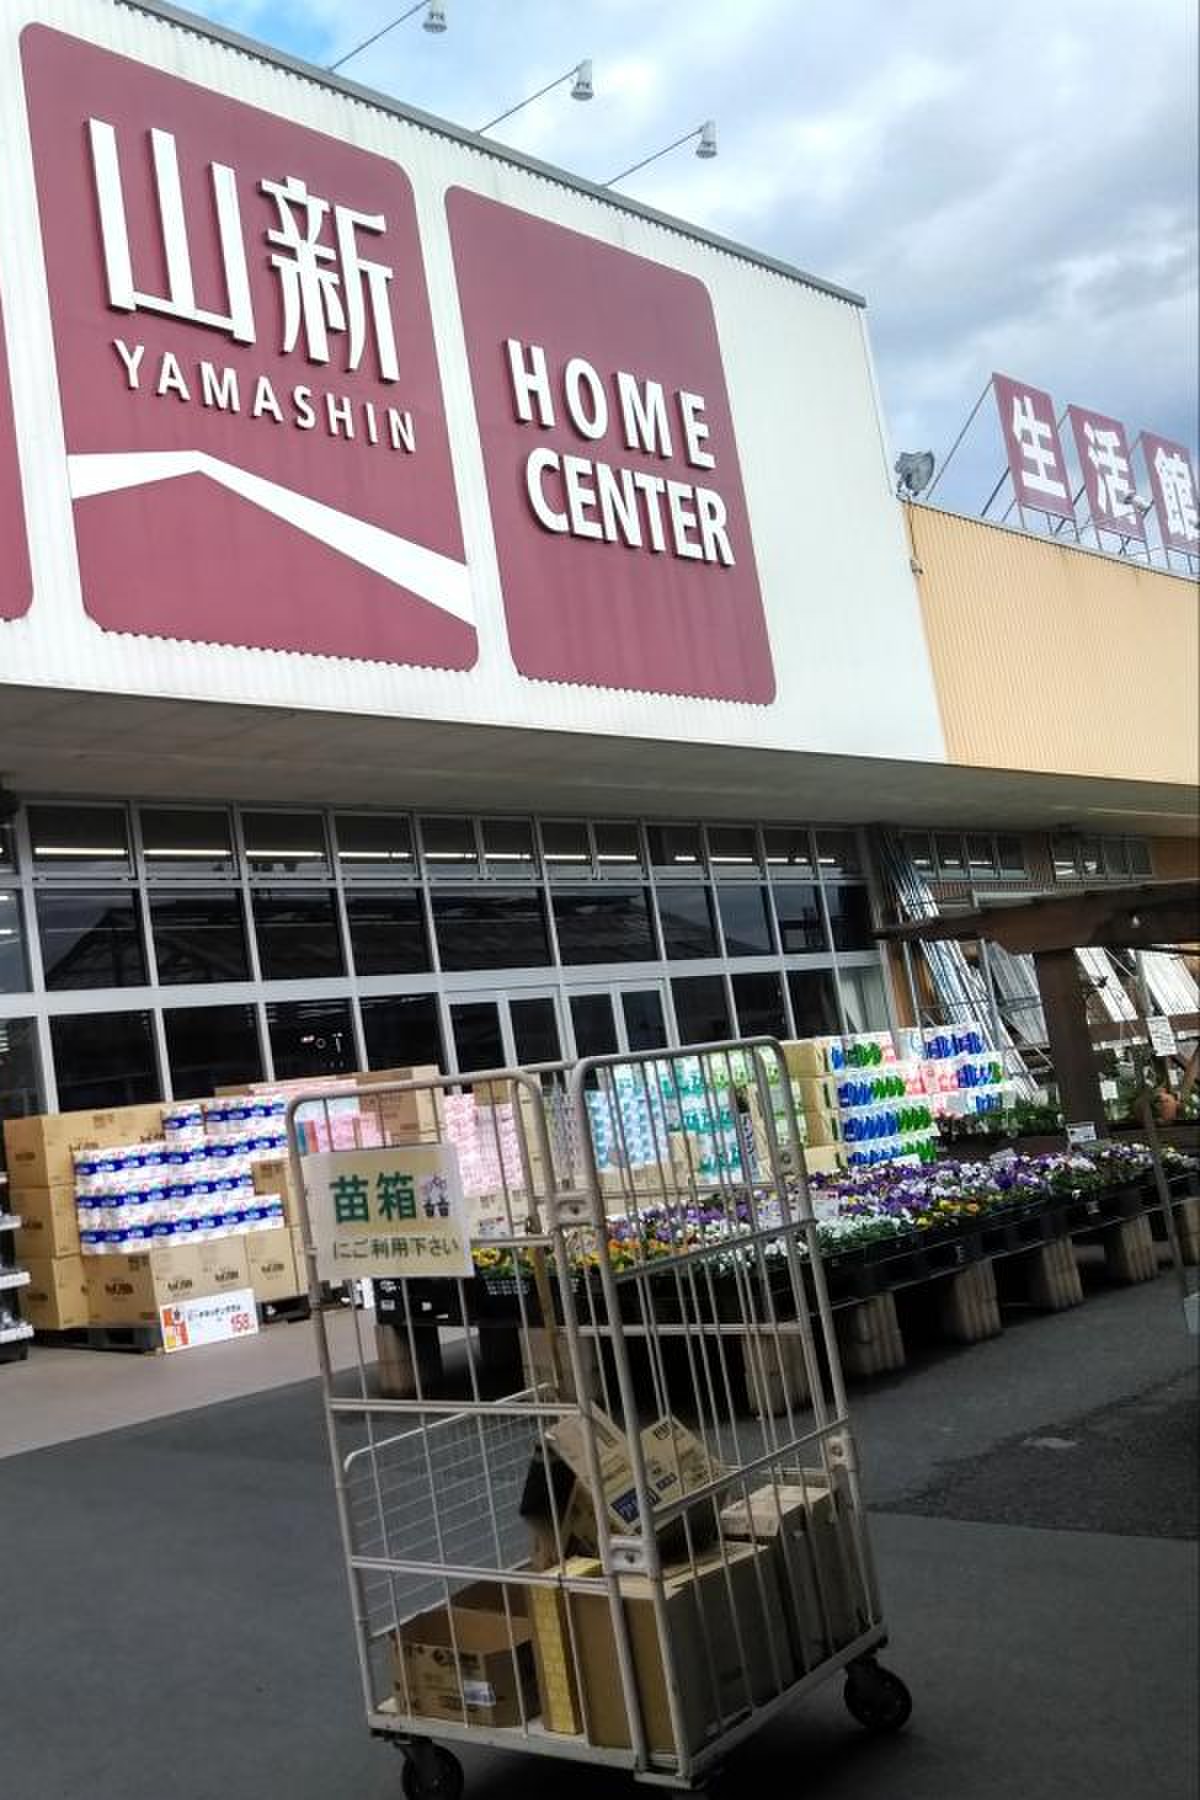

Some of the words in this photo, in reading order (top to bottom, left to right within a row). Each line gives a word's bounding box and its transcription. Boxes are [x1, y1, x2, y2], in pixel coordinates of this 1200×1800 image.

[89, 117, 400, 384] 山新
[112, 340, 416, 453] YAMASHIN
[505, 338, 716, 469] HOME
[525, 447, 735, 566] CENTER
[1012, 394, 1200, 541] 生活館
[329, 1171, 417, 1223] 苗箱
[333, 1237, 459, 1261] にご利用下さい
